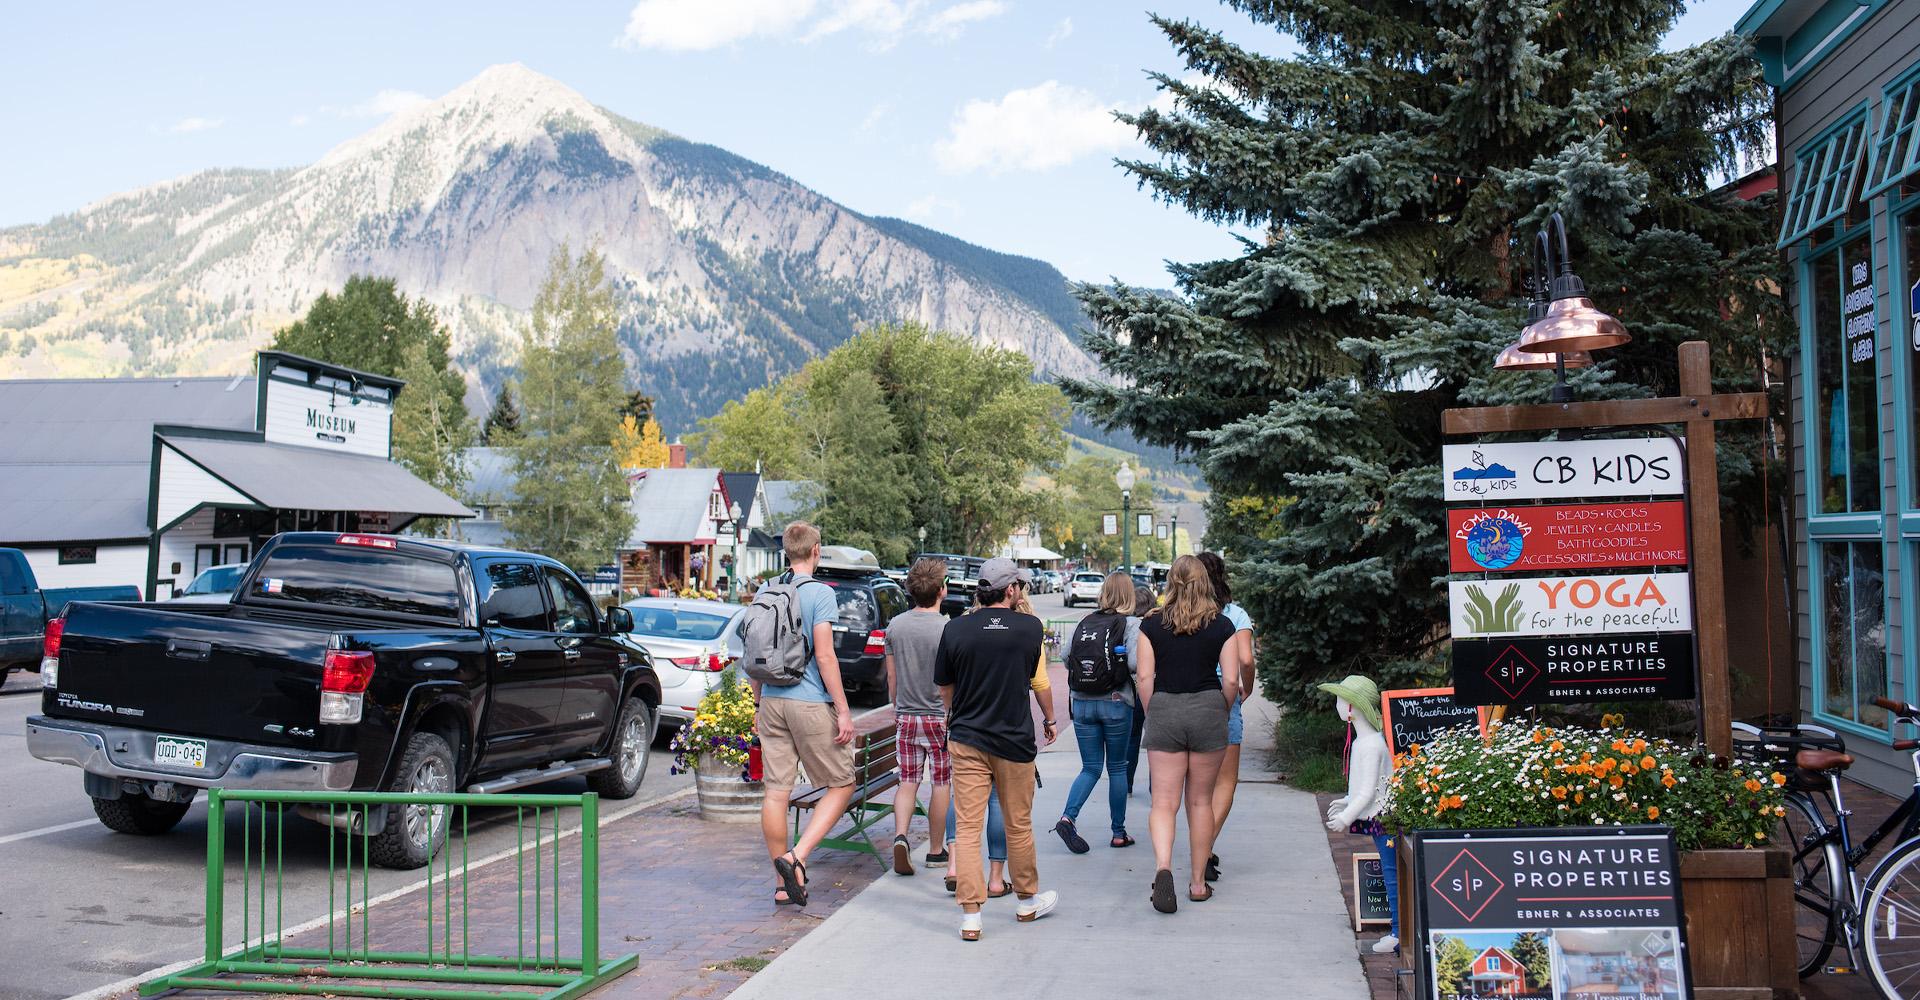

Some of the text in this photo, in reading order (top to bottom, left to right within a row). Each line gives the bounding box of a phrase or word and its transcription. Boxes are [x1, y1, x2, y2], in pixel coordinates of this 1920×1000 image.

[306, 407, 356, 434] MUSEUM
[1532, 454, 1671, 485] CB KIDS
[1453, 479, 1518, 492] CB KIDS
[1556, 507, 1648, 521] BEADS ROCKS
[1497, 509, 1532, 539] DAWA
[1543, 521, 1663, 536] JEWELRY CANDLES
[1557, 536, 1649, 550] BATH GOODIES
[1520, 552, 1607, 565] ACCESSORIES
[1615, 551, 1651, 562] MUCH
[1651, 549, 1687, 561] MORE
[1537, 576, 1668, 610] YOGA
[1531, 607, 1680, 631] for the peaceful!
[1547, 641, 1659, 657] SIGNATURE
[1547, 658, 1667, 674] PROPERTIES
[1549, 688, 1582, 697] EBNER
[1595, 686, 1657, 696] ASSOCIATES
[57, 698, 114, 713] TUNDRA
[1513, 848, 1661, 866] SIGNATURE
[1514, 870, 1672, 888] PROPERTIES
[1517, 910, 1560, 919] EBNER
[1579, 908, 1660, 918] ASSOCIATES
